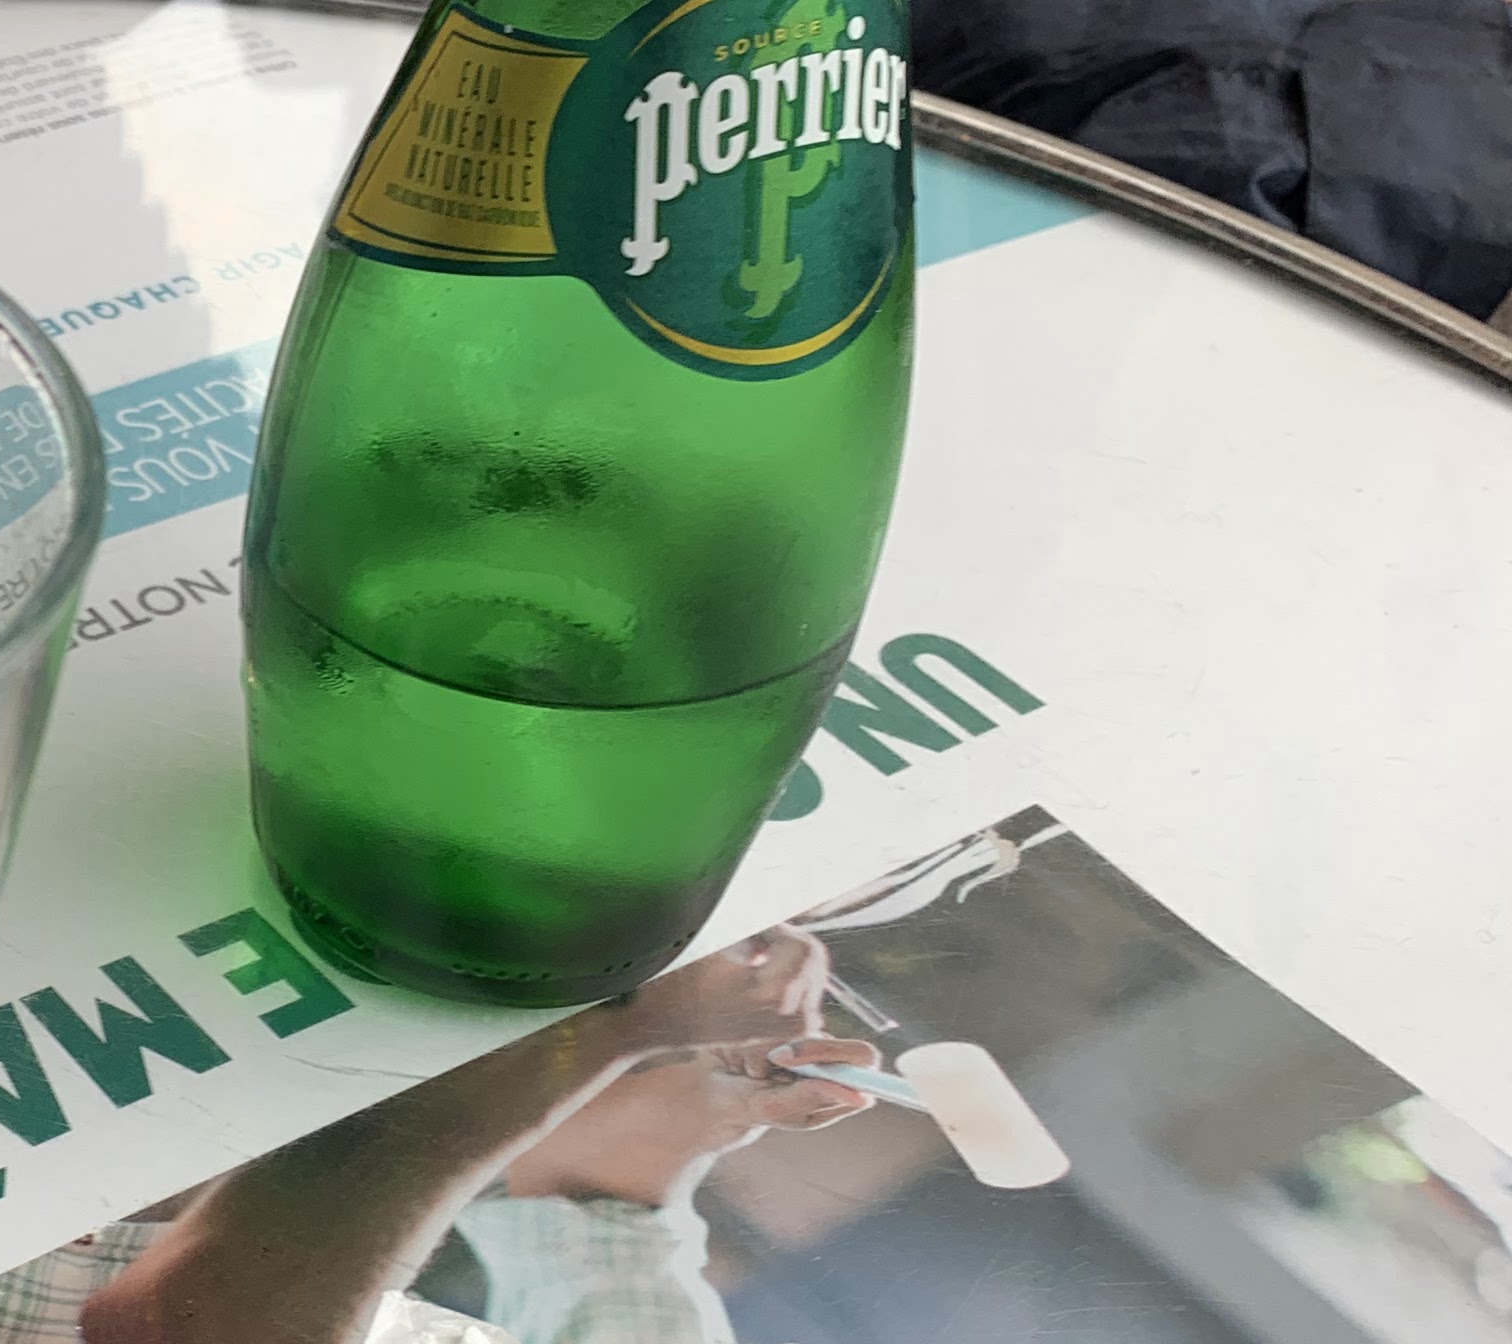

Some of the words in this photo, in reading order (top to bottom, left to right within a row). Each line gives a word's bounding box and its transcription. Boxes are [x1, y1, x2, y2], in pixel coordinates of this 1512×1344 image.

[713, 19, 824, 62] SOURCE
[456, 60, 502, 105] EAU
[619, 15, 907, 276] perrier
[115, 368, 264, 442] ACITÉS
[105, 436, 252, 502] VOUS
[65, 568, 231, 651] NOTR
[817, 633, 1046, 777] UN
